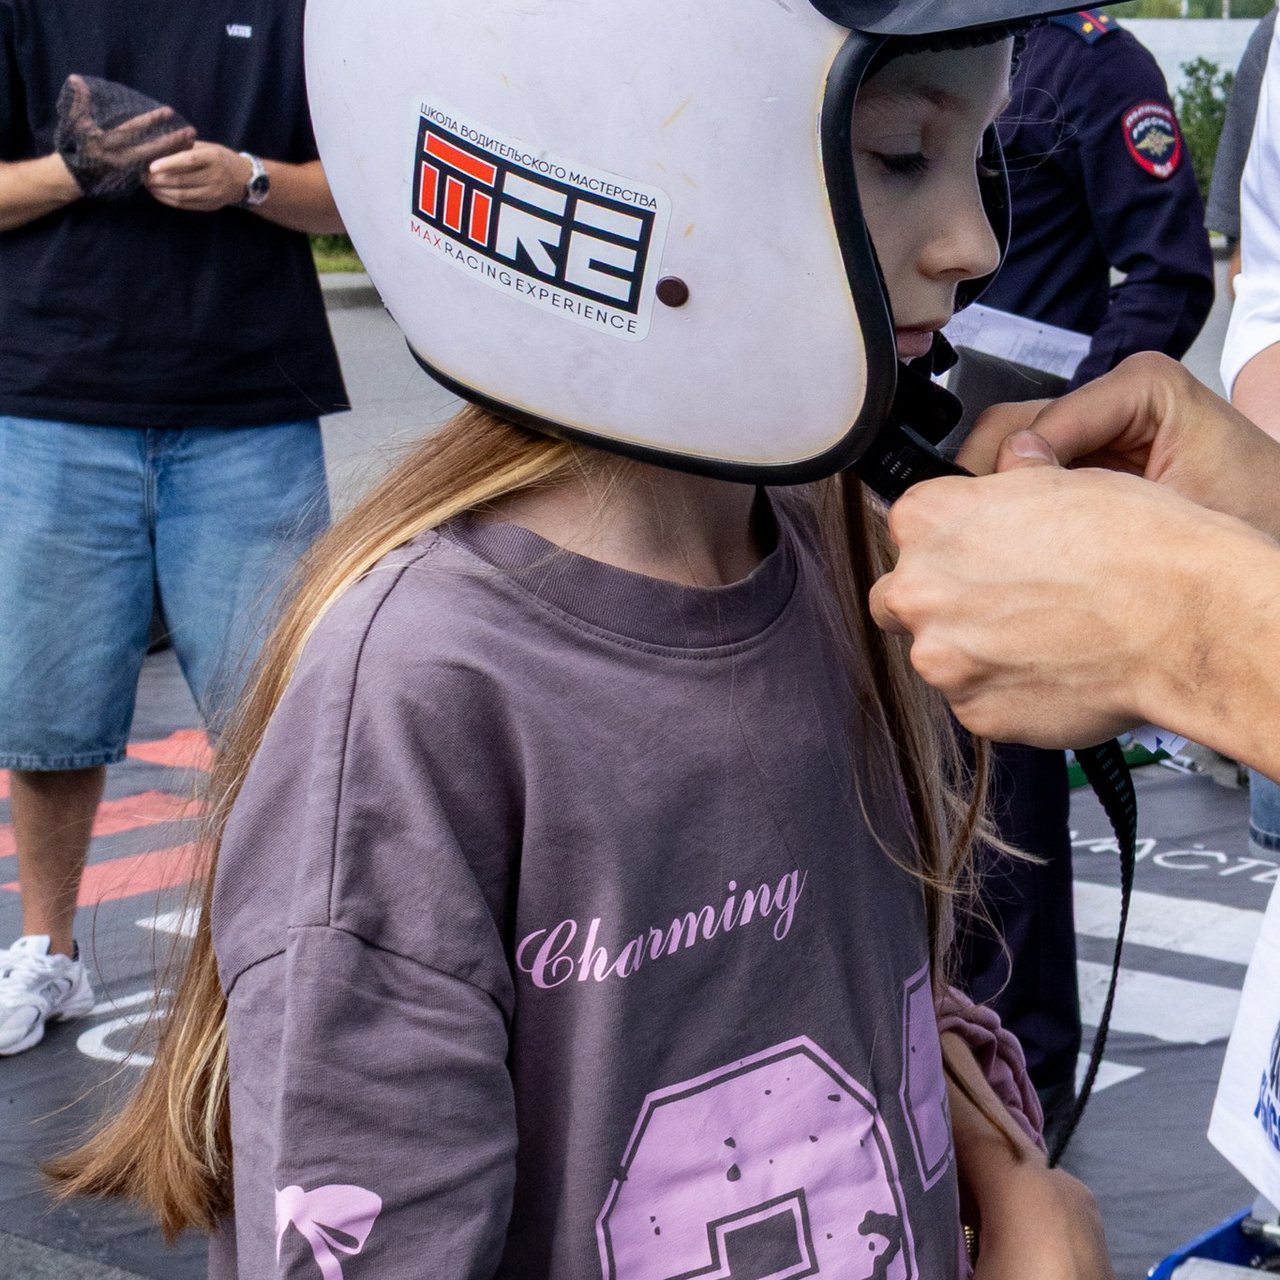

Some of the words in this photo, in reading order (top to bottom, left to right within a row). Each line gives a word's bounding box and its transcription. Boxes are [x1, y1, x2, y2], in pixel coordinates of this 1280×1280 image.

[420, 102, 458, 133] ШКОЛА
[460, 124, 566, 180] ВОДИТЕЛЬСКОГО
[568, 170, 657, 210] МАСТЕРСТВА
[516, 869, 808, 989] Charming
